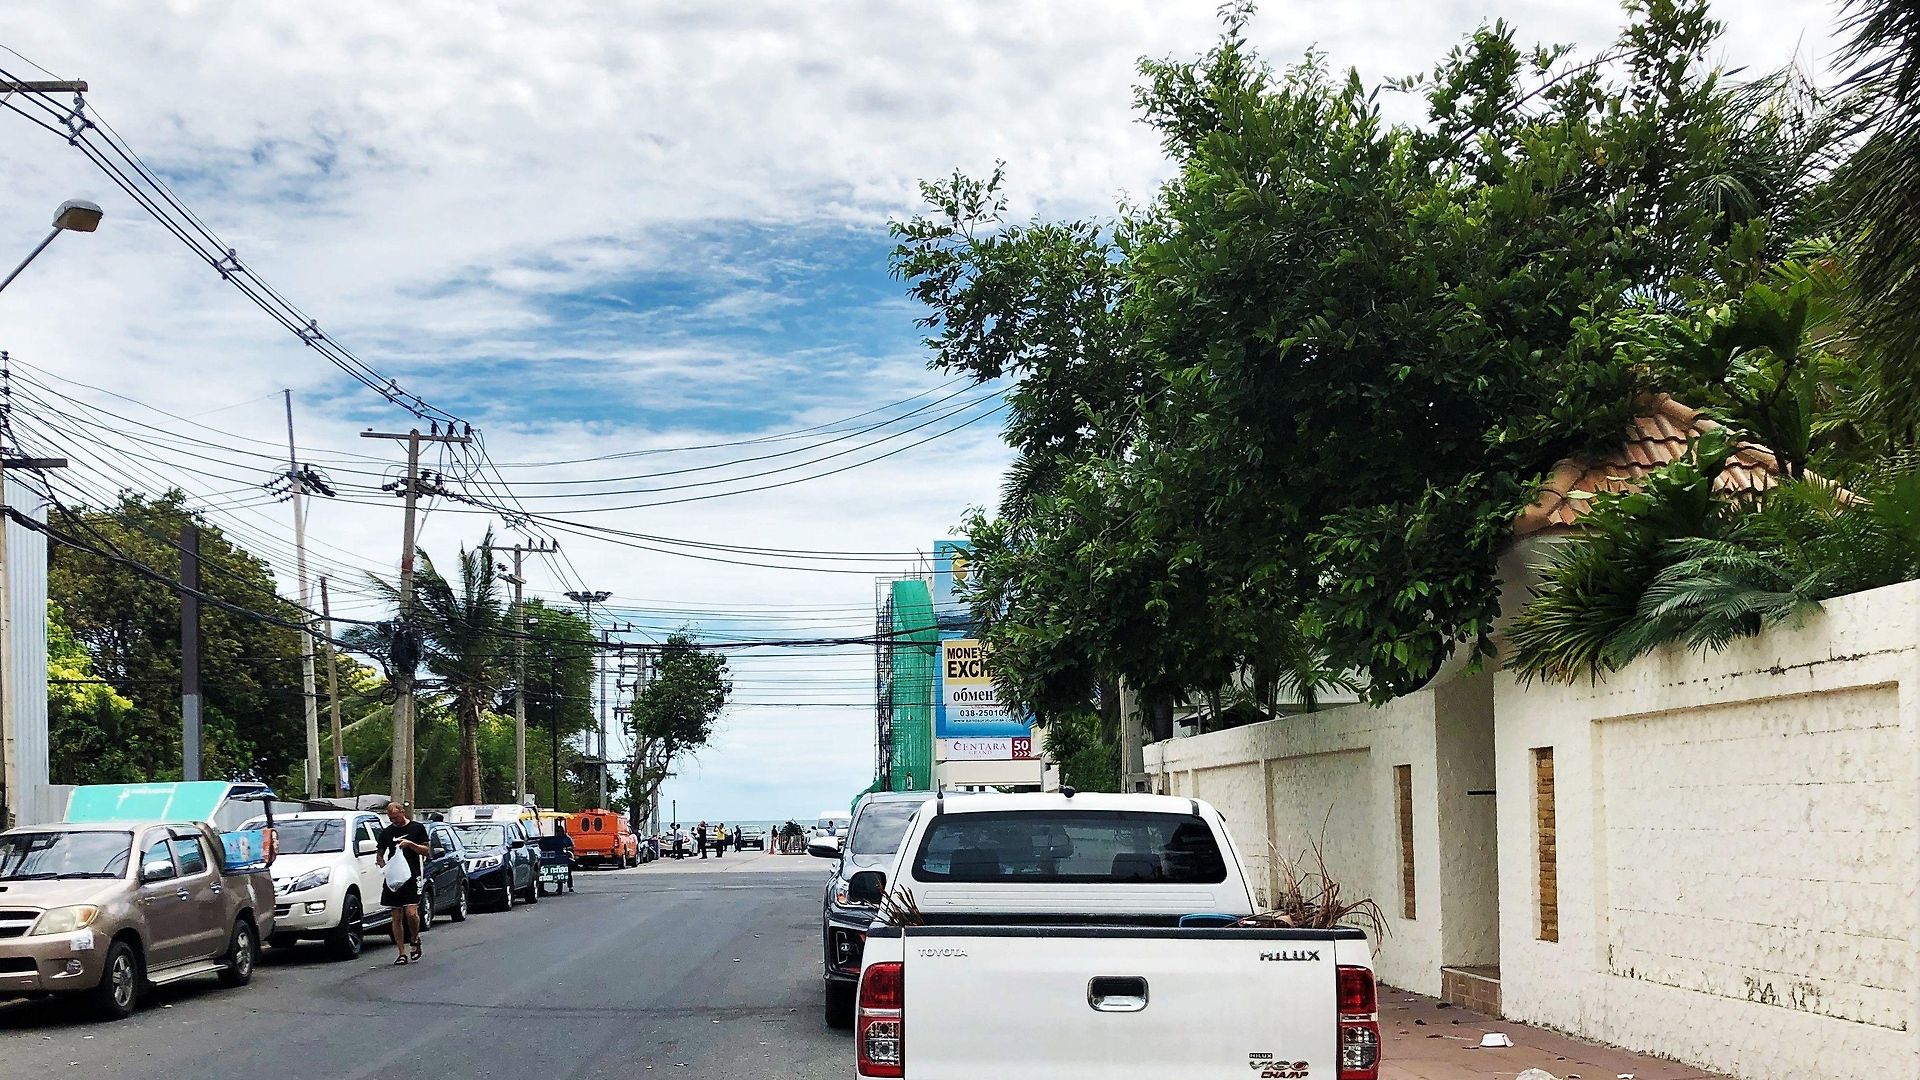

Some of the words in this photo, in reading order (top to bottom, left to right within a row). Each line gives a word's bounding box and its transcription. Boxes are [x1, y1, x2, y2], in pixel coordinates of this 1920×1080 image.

[947, 660, 992, 678] EXCH
[953, 687, 993, 702] обмен
[953, 741, 1007, 751] CENTARA
[1013, 740, 1029, 751] 50
[918, 948, 968, 957] TOYOTA
[1259, 950, 1321, 961] HILUX
[1261, 1071, 1309, 1079] CHAMP
